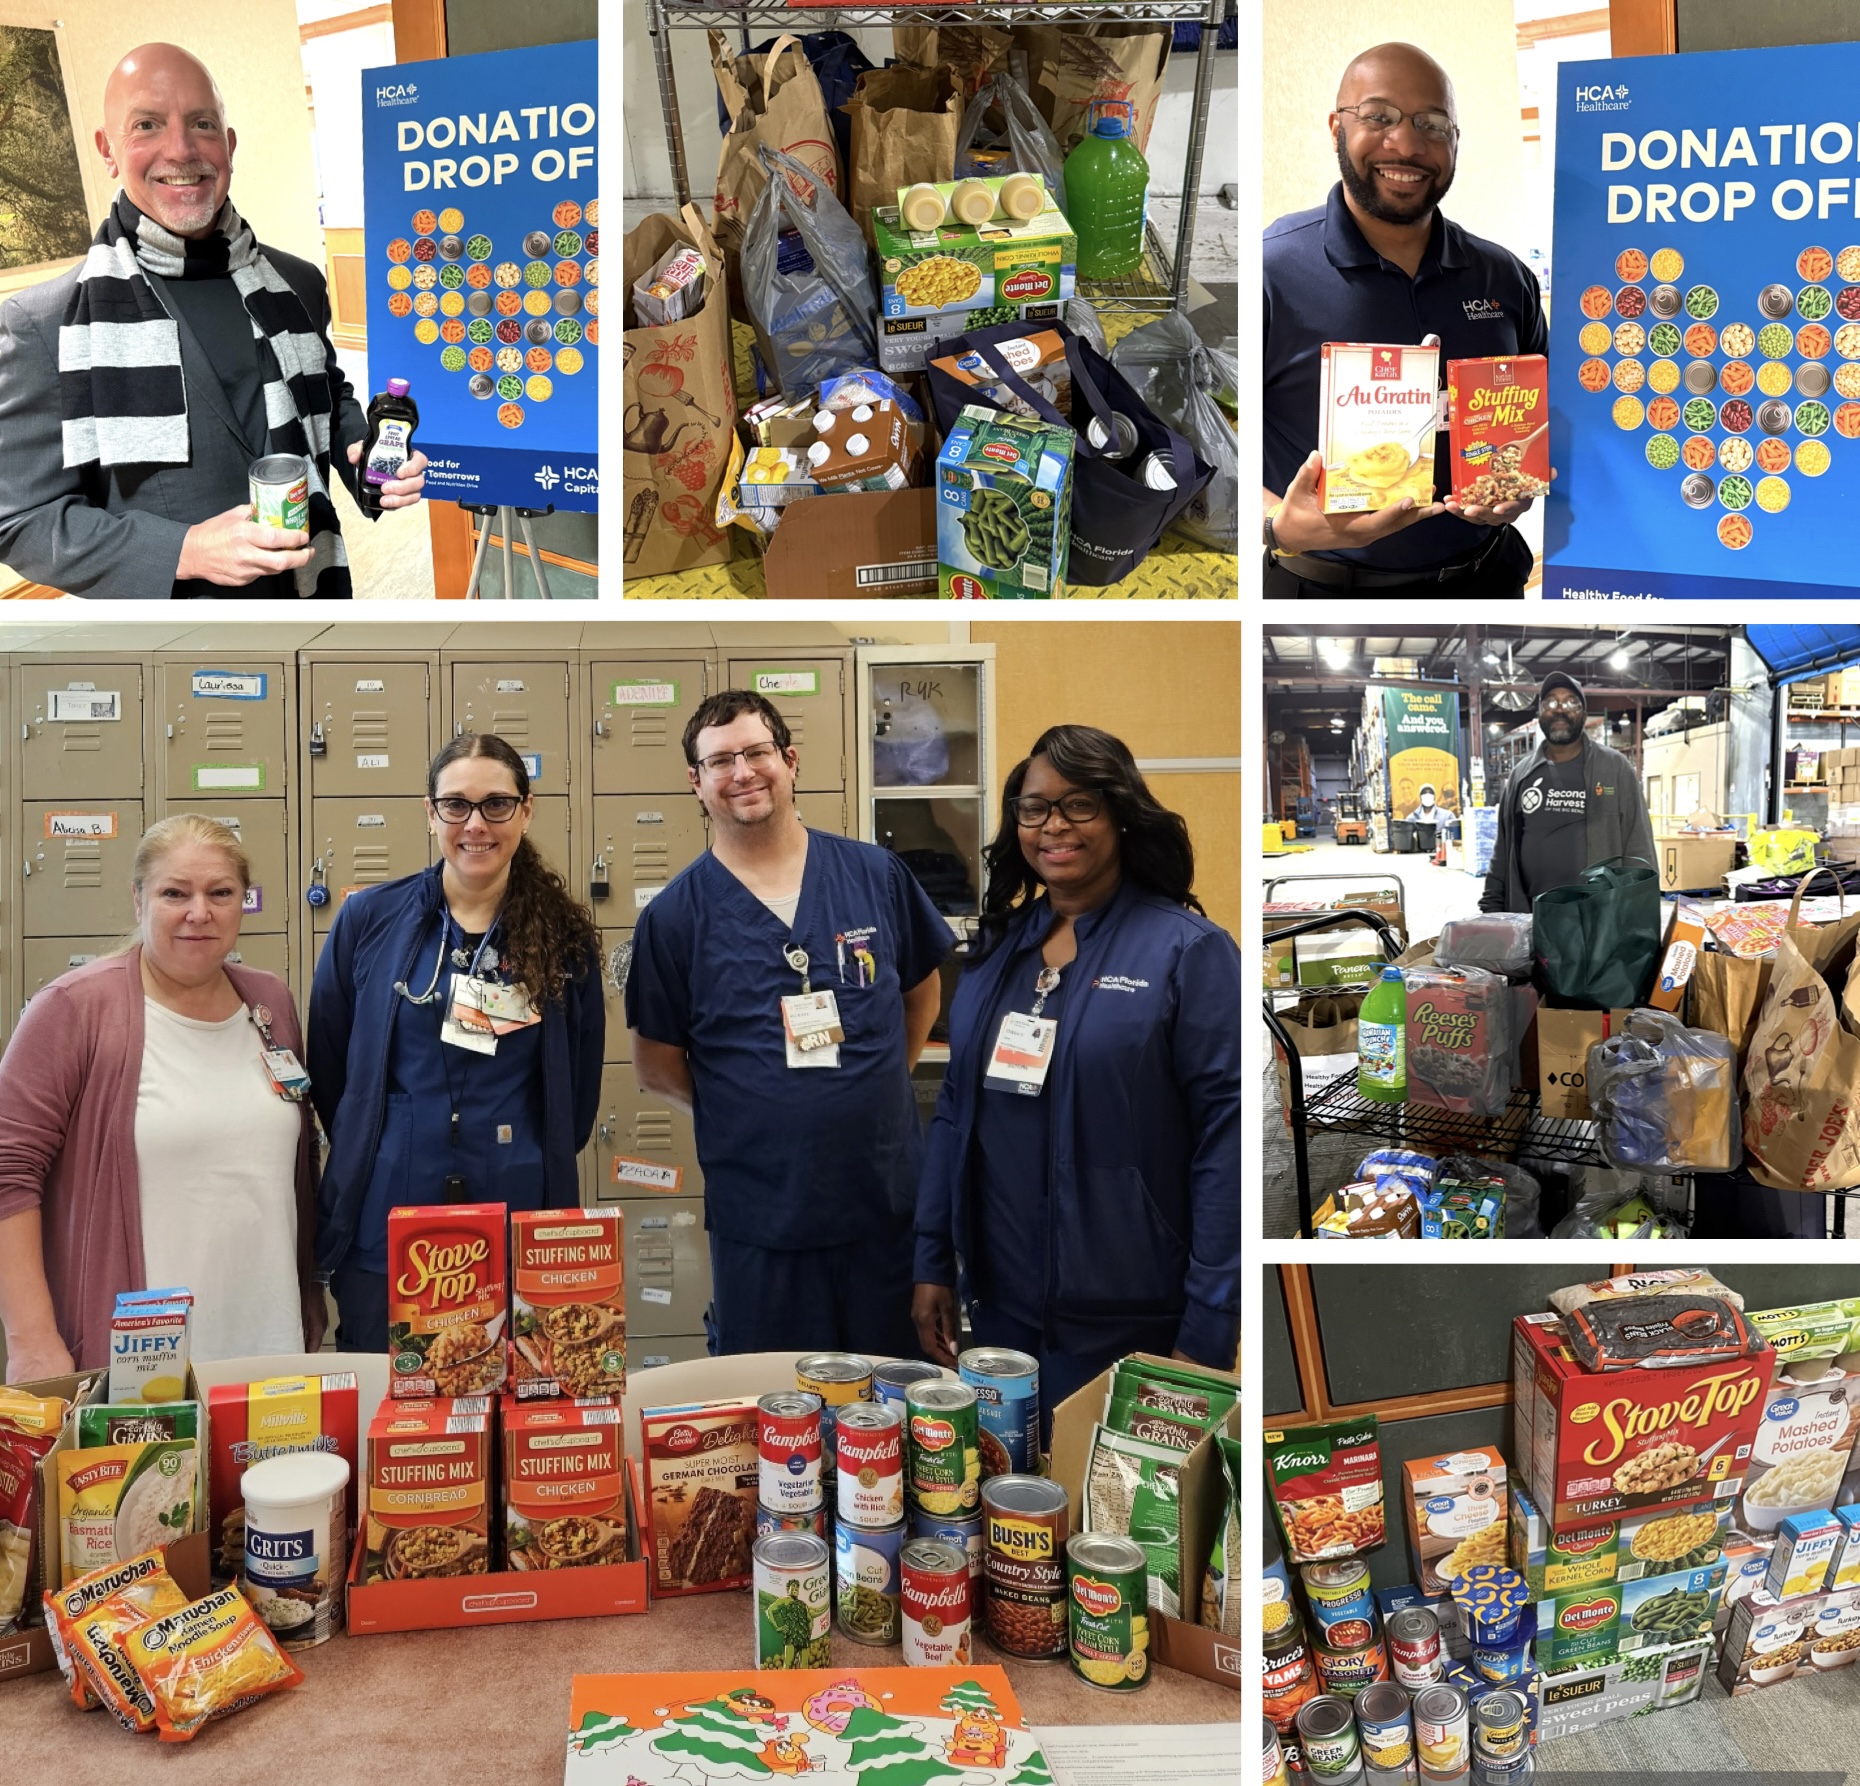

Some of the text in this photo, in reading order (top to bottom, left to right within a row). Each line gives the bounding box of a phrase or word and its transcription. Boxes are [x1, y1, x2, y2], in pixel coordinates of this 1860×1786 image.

[377, 85, 406, 98] HCA
[1575, 85, 1615, 102] HCA
[376, 96, 417, 107] Healthcare
[1575, 99, 1632, 112] Healthcare
[1602, 121, 1860, 172] DONATIO
[404, 153, 519, 191] DROP
[1607, 182, 1755, 224] DROP
[1005, 279, 1048, 291] Del Monte
[891, 304, 900, 314] 8
[1462, 299, 1492, 315] HCA
[1466, 311, 1505, 321] Healthcare
[1007, 342, 1026, 350] Instant
[889, 363, 895, 371] 8
[1337, 386, 1431, 407] Au Gratin
[1469, 386, 1539, 411] Stuffing
[1491, 406, 1526, 427] Mix
[379, 440, 404, 448] GRAPE
[428, 459, 460, 470] ood for
[426, 470, 480, 481] Tomorrows
[564, 467, 598, 481] HCA
[944, 491, 959, 502] 8
[1402, 693, 1442, 704] The call
[1408, 704, 1438, 713] came.
[1396, 722, 1450, 734] answered.
[1402, 714, 1444, 728] And you
[1547, 788, 1586, 800] Second
[1545, 798, 1585, 809] Harvest
[1332, 964, 1370, 975] Panera
[1670, 946, 1686, 979] Mashed
[1677, 949, 1694, 982] Potatoes
[1120, 978, 1149, 988] Florida
[1413, 1002, 1478, 1028] Reese's
[808, 1030, 831, 1047] RN
[1421, 1027, 1473, 1049] Puffs
[1819, 1104, 1849, 1146] JOE'S
[526, 1244, 612, 1265] STUFFING MIX
[397, 1239, 489, 1296] Stove
[542, 1270, 597, 1284] CHICKEN
[424, 1272, 476, 1309] Top
[114, 1315, 183, 1328] America's Favorite
[426, 1307, 478, 1330] CHICKEN
[1756, 1310, 1797, 1322] MOTT'S
[115, 1335, 181, 1354] JIFFY
[116, 1352, 177, 1364] corn muffin
[136, 1364, 157, 1372] mix
[261, 1411, 308, 1429] Millville
[1778, 1418, 1838, 1440] Mashed
[1267, 1433, 1282, 1441] NEW
[1636, 1427, 1680, 1448] Stuffing Mix
[1772, 1433, 1834, 1455] Potatoes
[838, 1436, 899, 1464] Campbell's
[163, 1459, 177, 1469] 90
[520, 1453, 612, 1476] STUFFING MIX
[684, 1455, 741, 1469] SUPER MOIST
[1274, 1454, 1328, 1471] Knorr
[1343, 1452, 1377, 1465] MARINARA
[1715, 1460, 1724, 1471] 6
[73, 1464, 123, 1489] TASTY BITE
[381, 1462, 474, 1484] STUFFING MIX
[537, 1482, 596, 1496] CHICKEN
[778, 1479, 815, 1489] Vegetarian
[388, 1488, 467, 1504] CORNBREAD
[780, 1489, 813, 1498] Vegetable
[855, 1493, 884, 1503] Chicken
[854, 1502, 886, 1511] with Rice
[1428, 1499, 1450, 1509] Great
[1467, 1503, 1489, 1511] Three
[1574, 1497, 1622, 1514] TURKEY
[71, 1504, 112, 1521] Organic
[1454, 1509, 1489, 1522] Cheese
[69, 1523, 113, 1536] Basmati
[86, 1537, 113, 1549] Rice
[992, 1525, 1050, 1552] BUSH'S
[1796, 1537, 1836, 1554] JIFFY
[250, 1537, 303, 1559] GRITS
[1572, 1541, 1594, 1551] Quality
[1011, 1549, 1029, 1558] BEST
[262, 1562, 284, 1571] Quick
[867, 1566, 883, 1575] Cut
[984, 1552, 1061, 1580] Country Style
[1567, 1562, 1602, 1573] WHOLE
[1549, 1565, 1611, 1585] KERNEL CORN
[994, 1587, 1050, 1604] BAKED BEANS
[1321, 1590, 1363, 1608] PROGRESSO
[157, 1590, 238, 1636] Maruchan
[1331, 1607, 1357, 1617] VEGETABLE
[1773, 1628, 1799, 1641] Turkey
[1580, 1638, 1598, 1646] CUT
[925, 1651, 943, 1662] Beef
[1390, 1641, 1437, 1660] Campbell's
[1322, 1655, 1365, 1669] GLORY
[1265, 1664, 1302, 1686] YAMS
[1542, 1691, 1651, 1727] sweet peas
[1311, 1746, 1343, 1756] GREEN
[1312, 1753, 1344, 1762] BEANS
